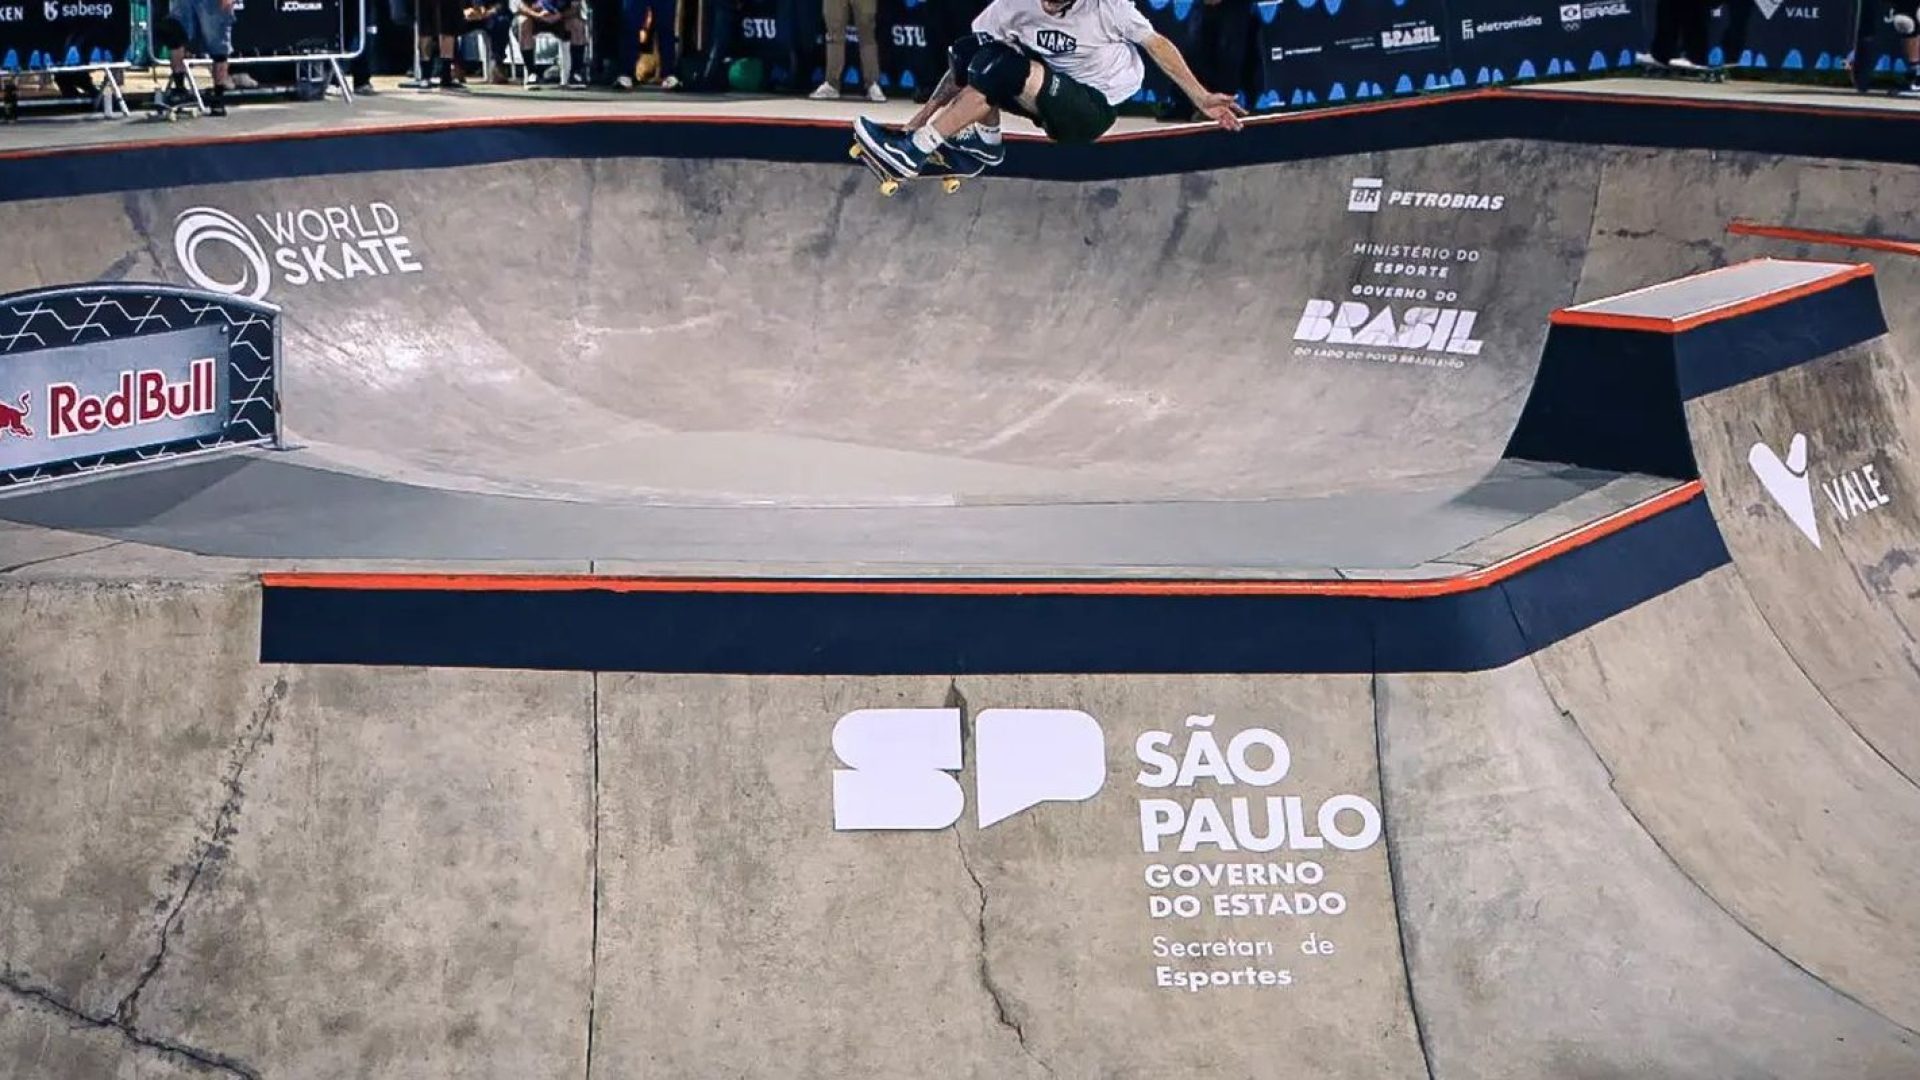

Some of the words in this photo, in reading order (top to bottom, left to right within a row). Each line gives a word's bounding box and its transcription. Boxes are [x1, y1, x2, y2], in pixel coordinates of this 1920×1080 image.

[62, 0, 113, 19] sabesp
[1582, 3, 1631, 20] BRASIL
[1785, 7, 1820, 19] VALE
[742, 18, 776, 39] STU
[891, 25, 927, 47] STU
[1381, 25, 1441, 49] BRASIL
[1039, 31, 1075, 52] VANS
[1387, 191, 1505, 211] PETROBRAS
[256, 202, 400, 246] WORLD
[275, 236, 423, 286] SKATE
[1353, 243, 1451, 261] MINISTÉRIO
[1456, 250, 1480, 262] DO
[1373, 262, 1450, 279] ESPORTE
[1351, 284, 1428, 300] GOVERNO
[1434, 291, 1458, 302] DO
[1293, 298, 1484, 355] BRASIL
[48, 371, 134, 438] Red
[136, 358, 216, 424] Bull
[1821, 463, 1890, 522] VALE
[1135, 714, 1291, 788] SÃO
[831, 707, 1107, 831] SP
[1139, 794, 1382, 853] PAULO
[1144, 861, 1325, 888] GOVERNO
[1149, 894, 1201, 918] DO
[1213, 891, 1347, 916] ESTADO
[1300, 932, 1335, 956] de
[1156, 966, 1293, 993] Esportes
